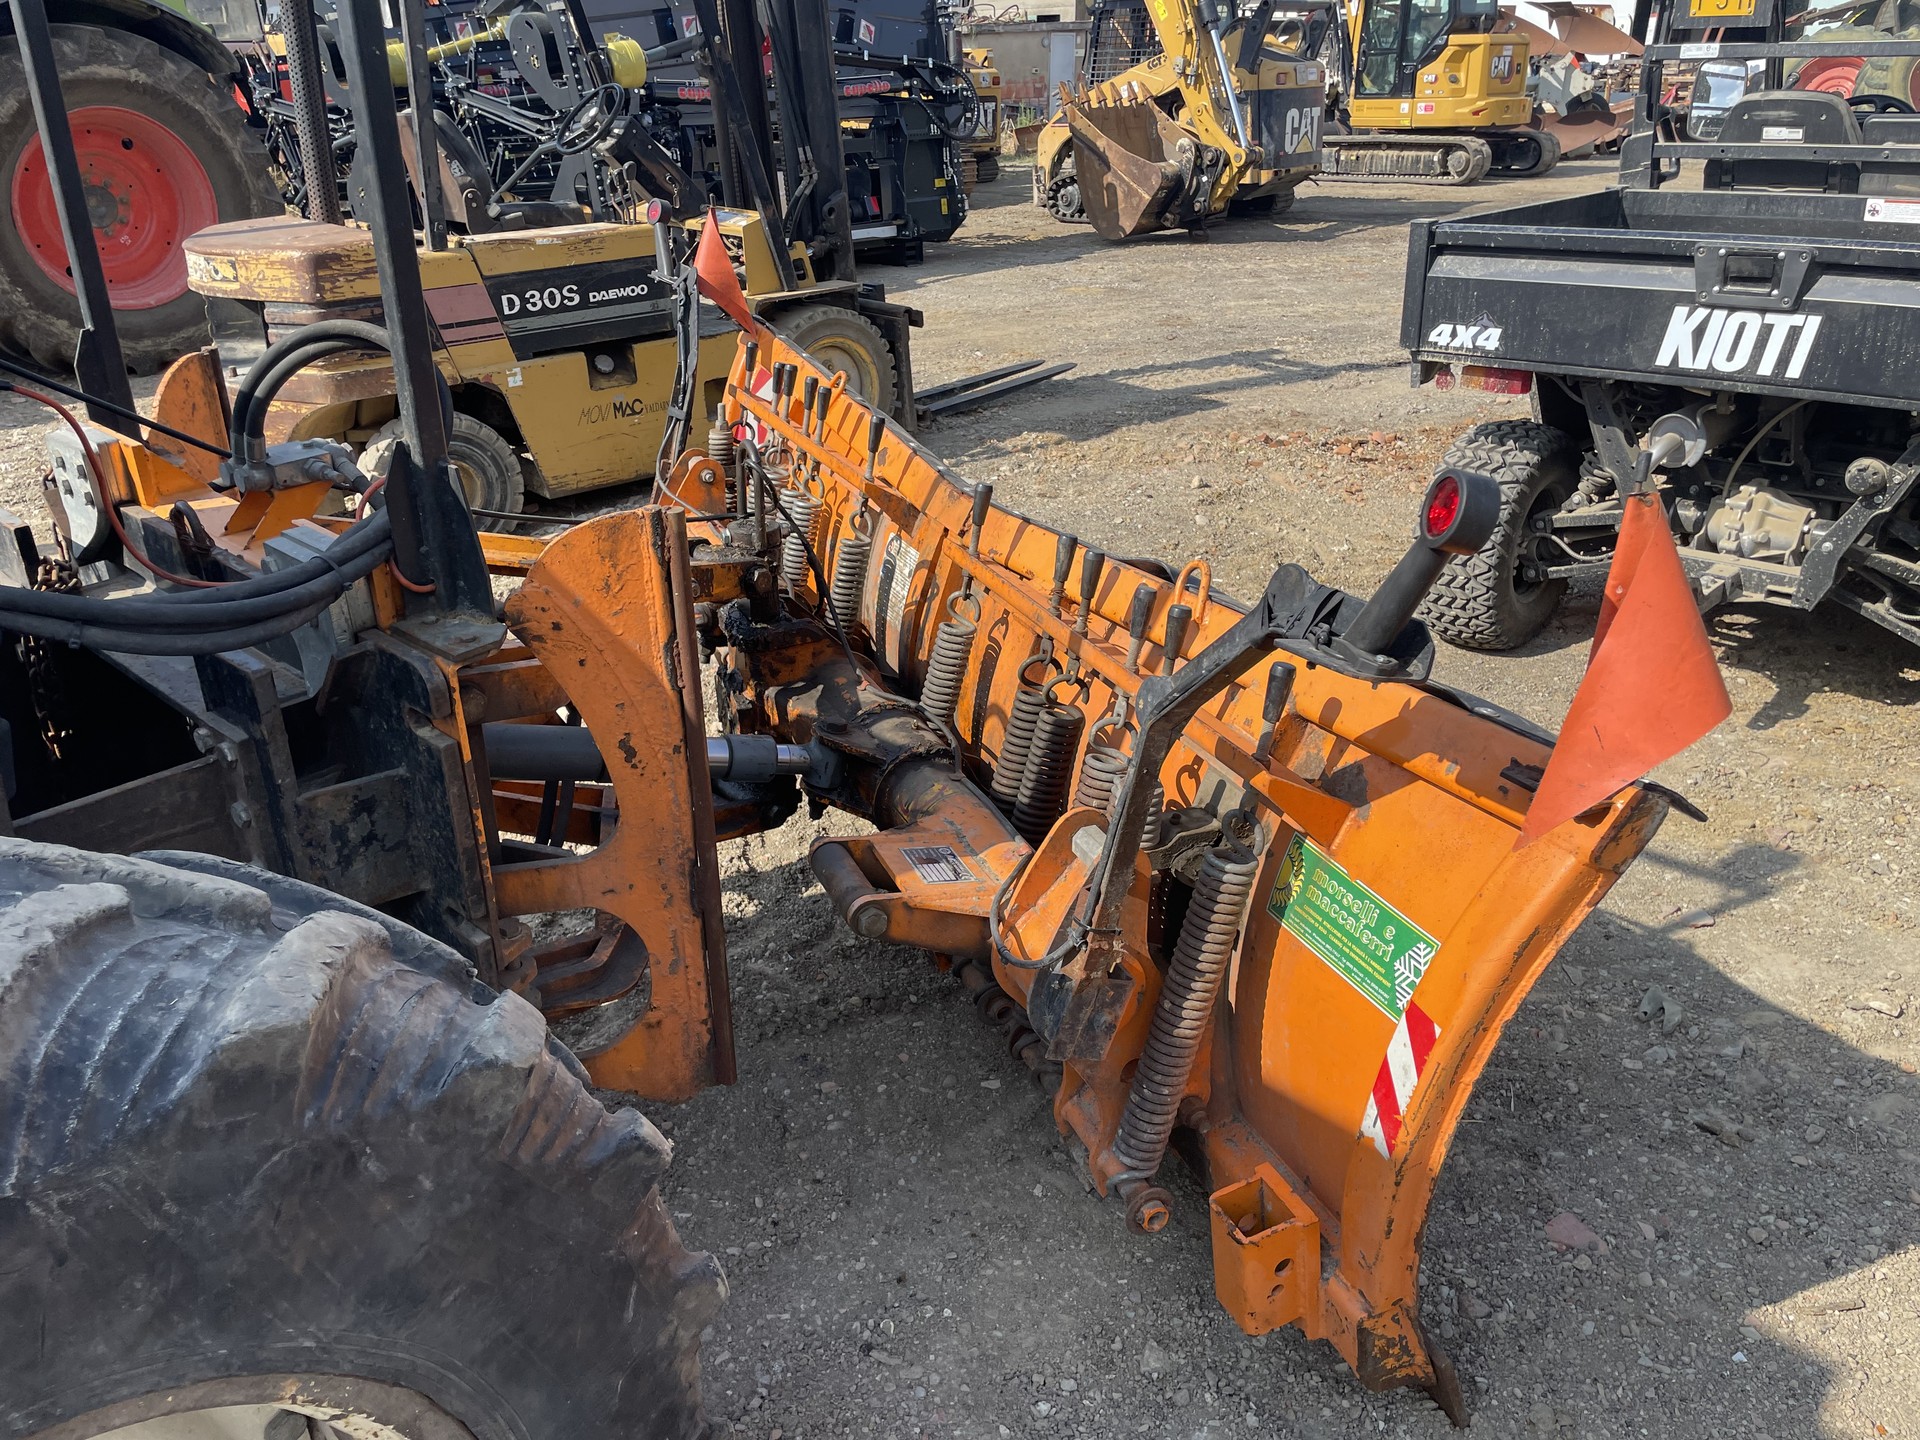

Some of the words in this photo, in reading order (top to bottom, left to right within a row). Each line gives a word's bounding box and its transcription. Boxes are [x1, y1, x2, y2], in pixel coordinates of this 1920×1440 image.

[1490, 56, 1512, 79] CAT
[1285, 107, 1320, 155] CAT
[588, 283, 648, 303] DAEWOO
[1654, 305, 1823, 379] KIOTI
[1305, 884, 1395, 962] maccaferri
[1311, 868, 1380, 928] morselli
[1382, 925, 1396, 941] e
